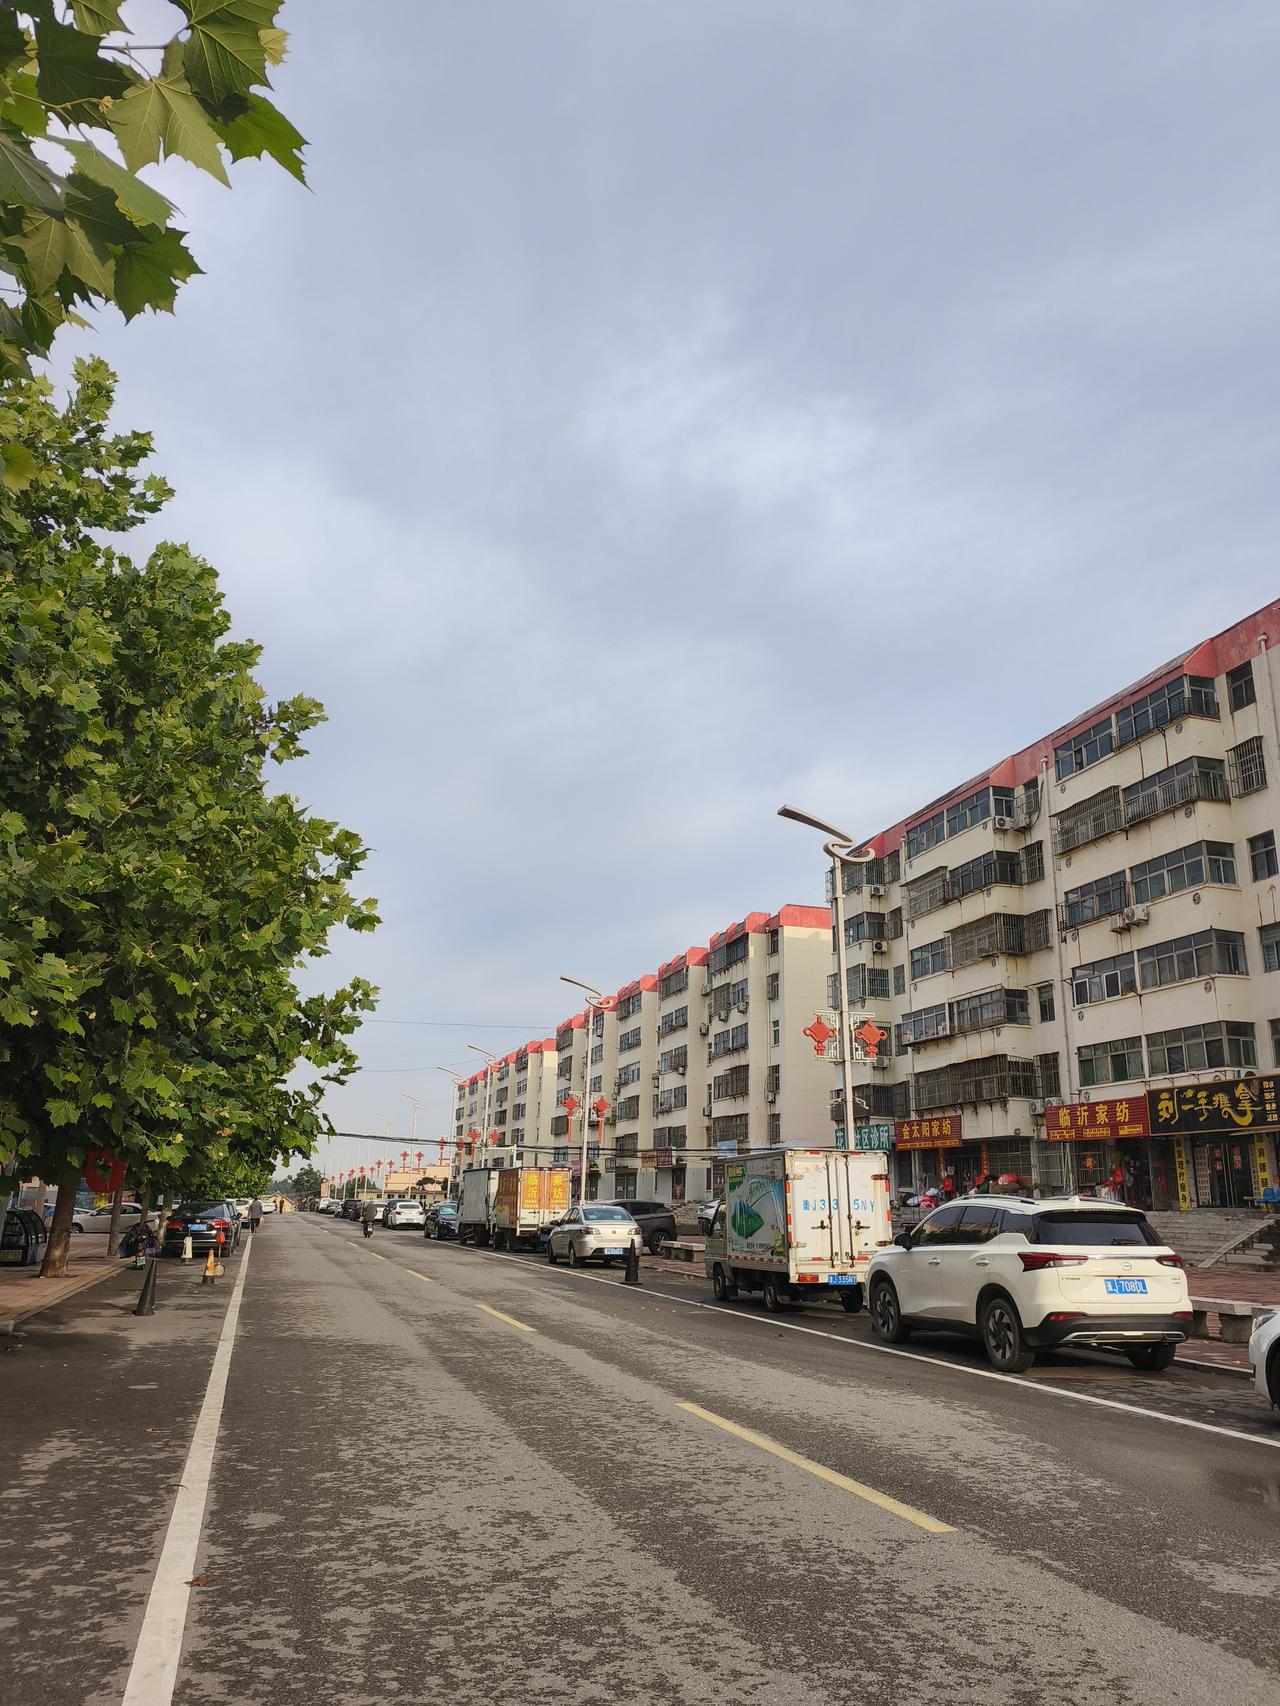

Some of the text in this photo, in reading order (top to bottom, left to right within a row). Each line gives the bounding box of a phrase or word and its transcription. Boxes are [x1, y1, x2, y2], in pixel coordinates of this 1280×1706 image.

[1059, 1101, 1129, 1128] 临沂家纺
[902, 1119, 951, 1139] 金太阳家纺
[527, 1174, 538, 1198] 临沂
[552, 1174, 563, 1199] 家纺
